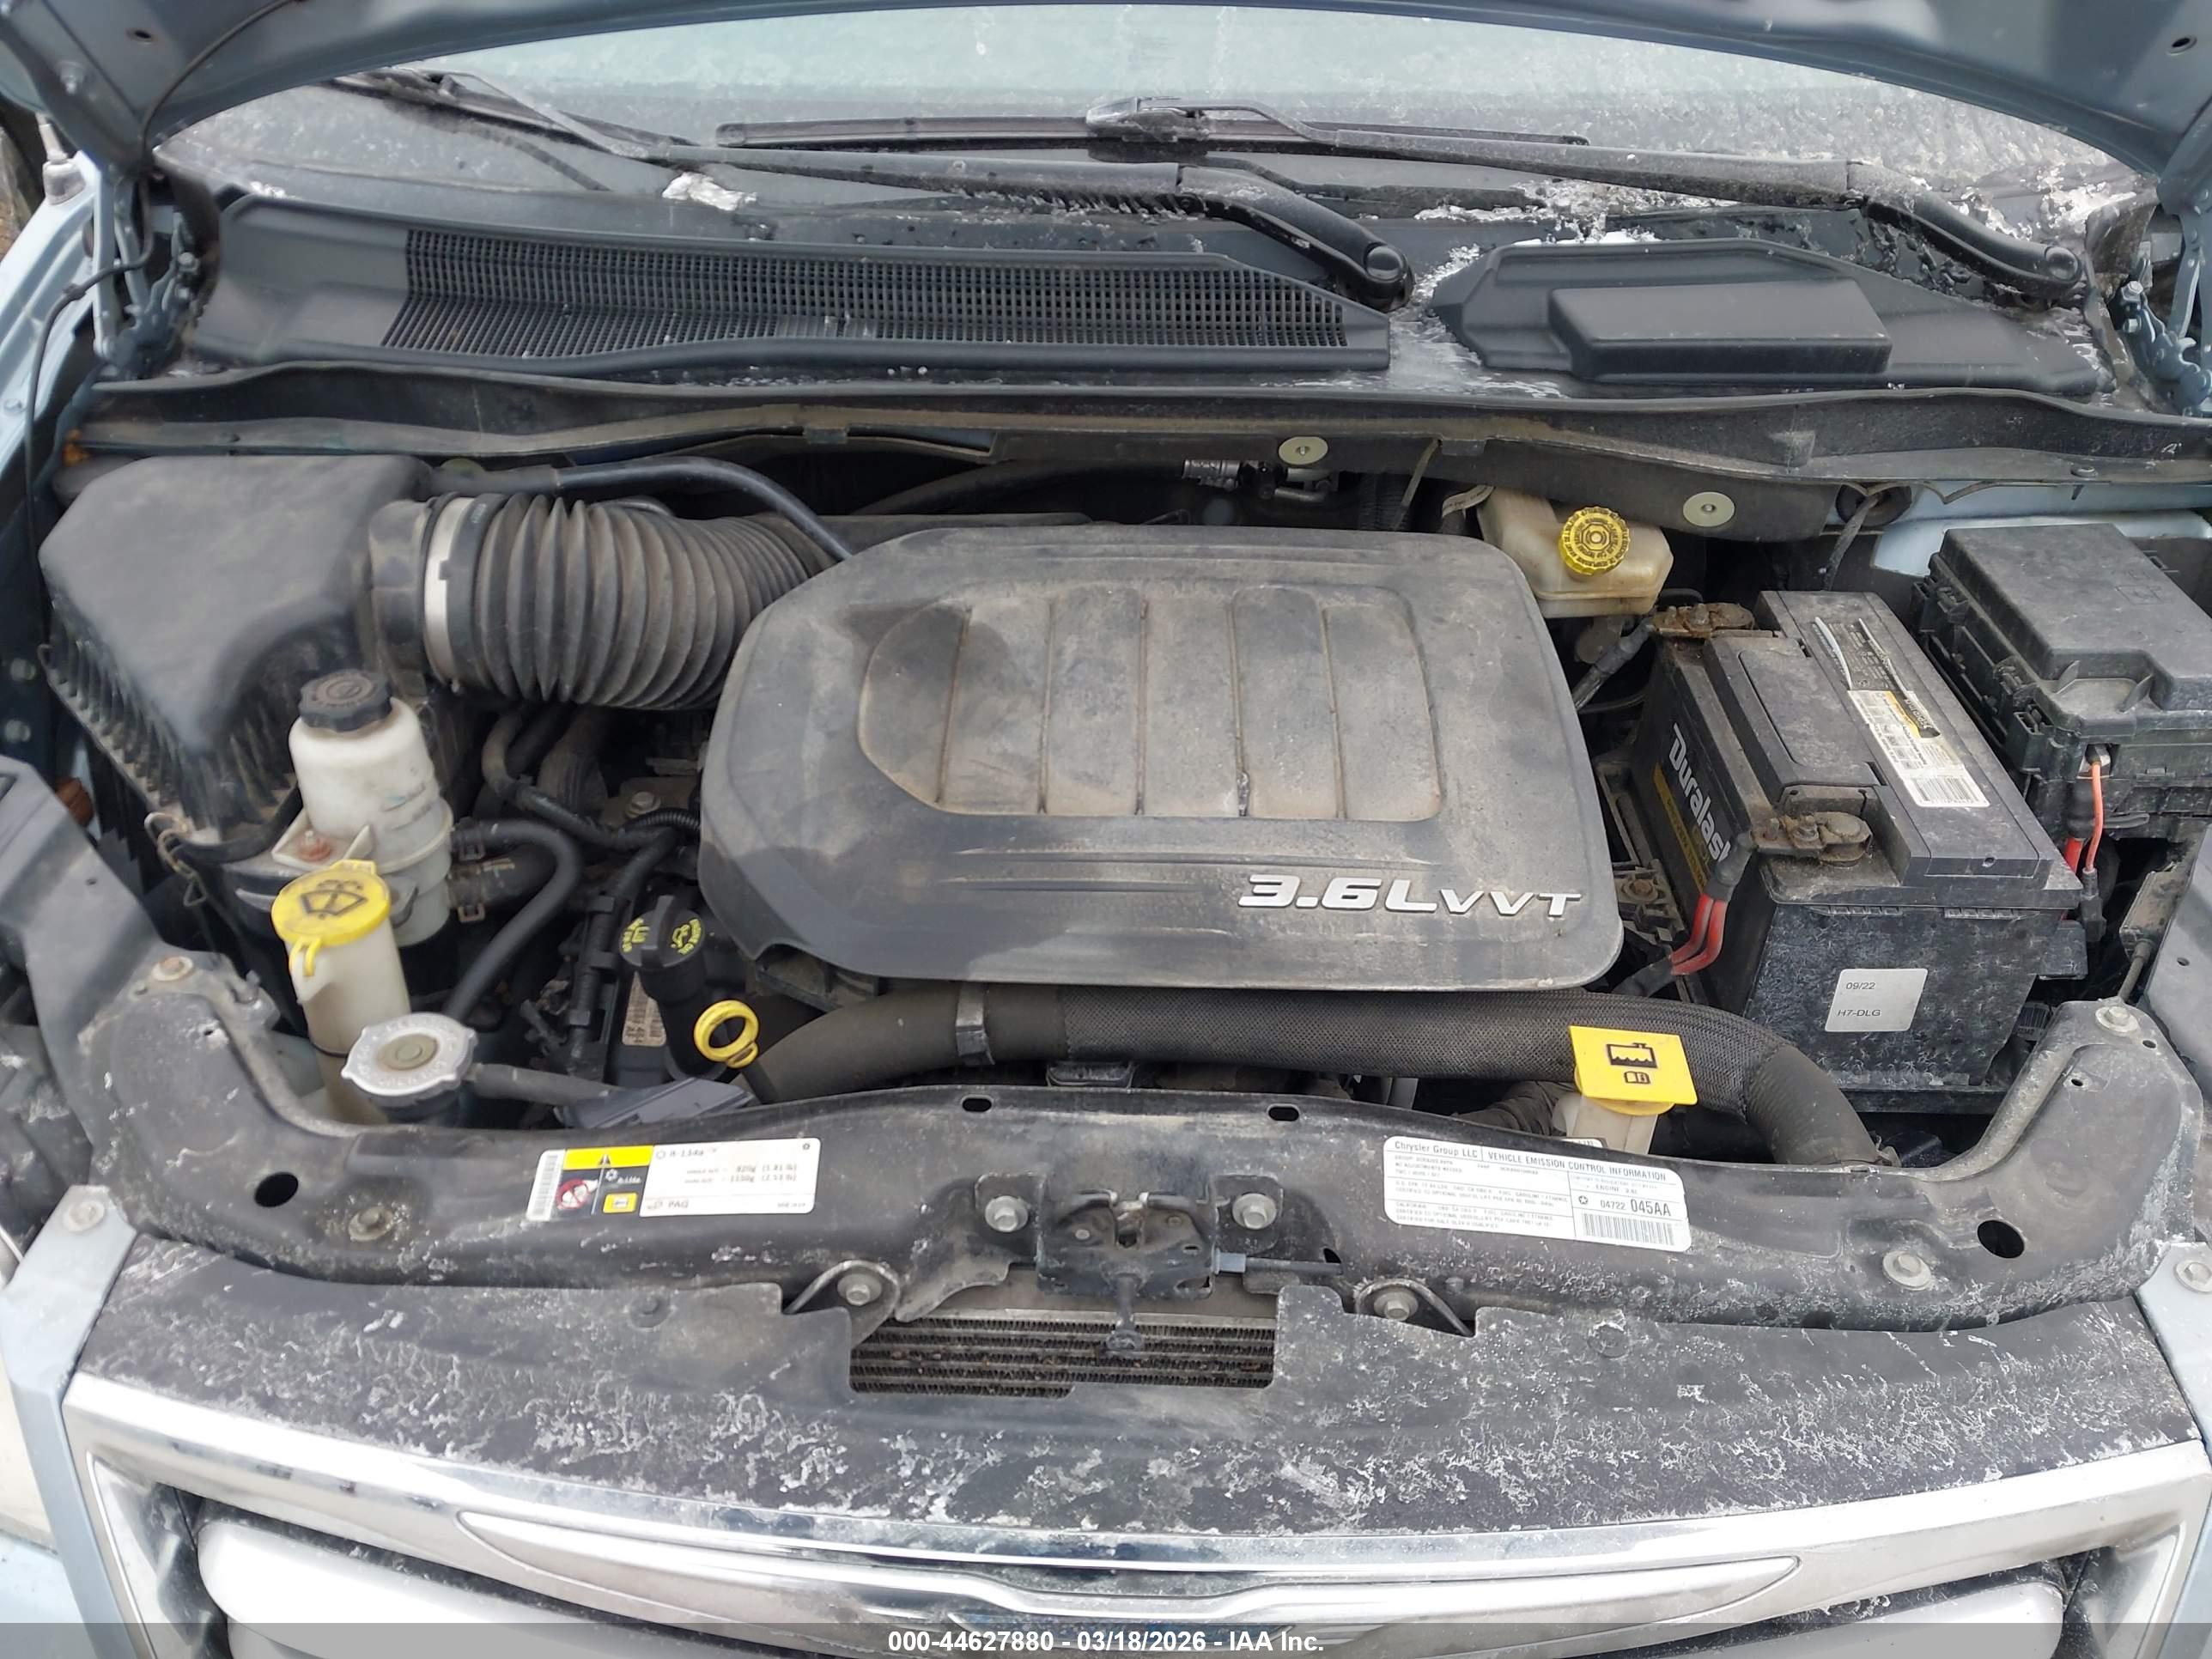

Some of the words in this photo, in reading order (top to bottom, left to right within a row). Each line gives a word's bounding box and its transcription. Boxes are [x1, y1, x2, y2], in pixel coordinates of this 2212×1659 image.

[1668, 722, 1731, 862] Duralast
[1237, 873, 1438, 913] 3.6L
[1440, 888, 1583, 917] VVT
[1845, 981, 1876, 990] 09/22
[1395, 1141, 1430, 1154] Chrysler
[1433, 1146, 1459, 1157] Group
[1462, 1149, 1478, 1158] LLC
[1488, 1152, 1522, 1164] VEHICLE
[1526, 1156, 1565, 1168] EMISSION
[1569, 1161, 1606, 1174] CONTROL
[1609, 1167, 1667, 1181] INFORMATION
[1600, 1200, 1626, 1210] 04722
[1631, 1199, 1671, 1216] 045AA
